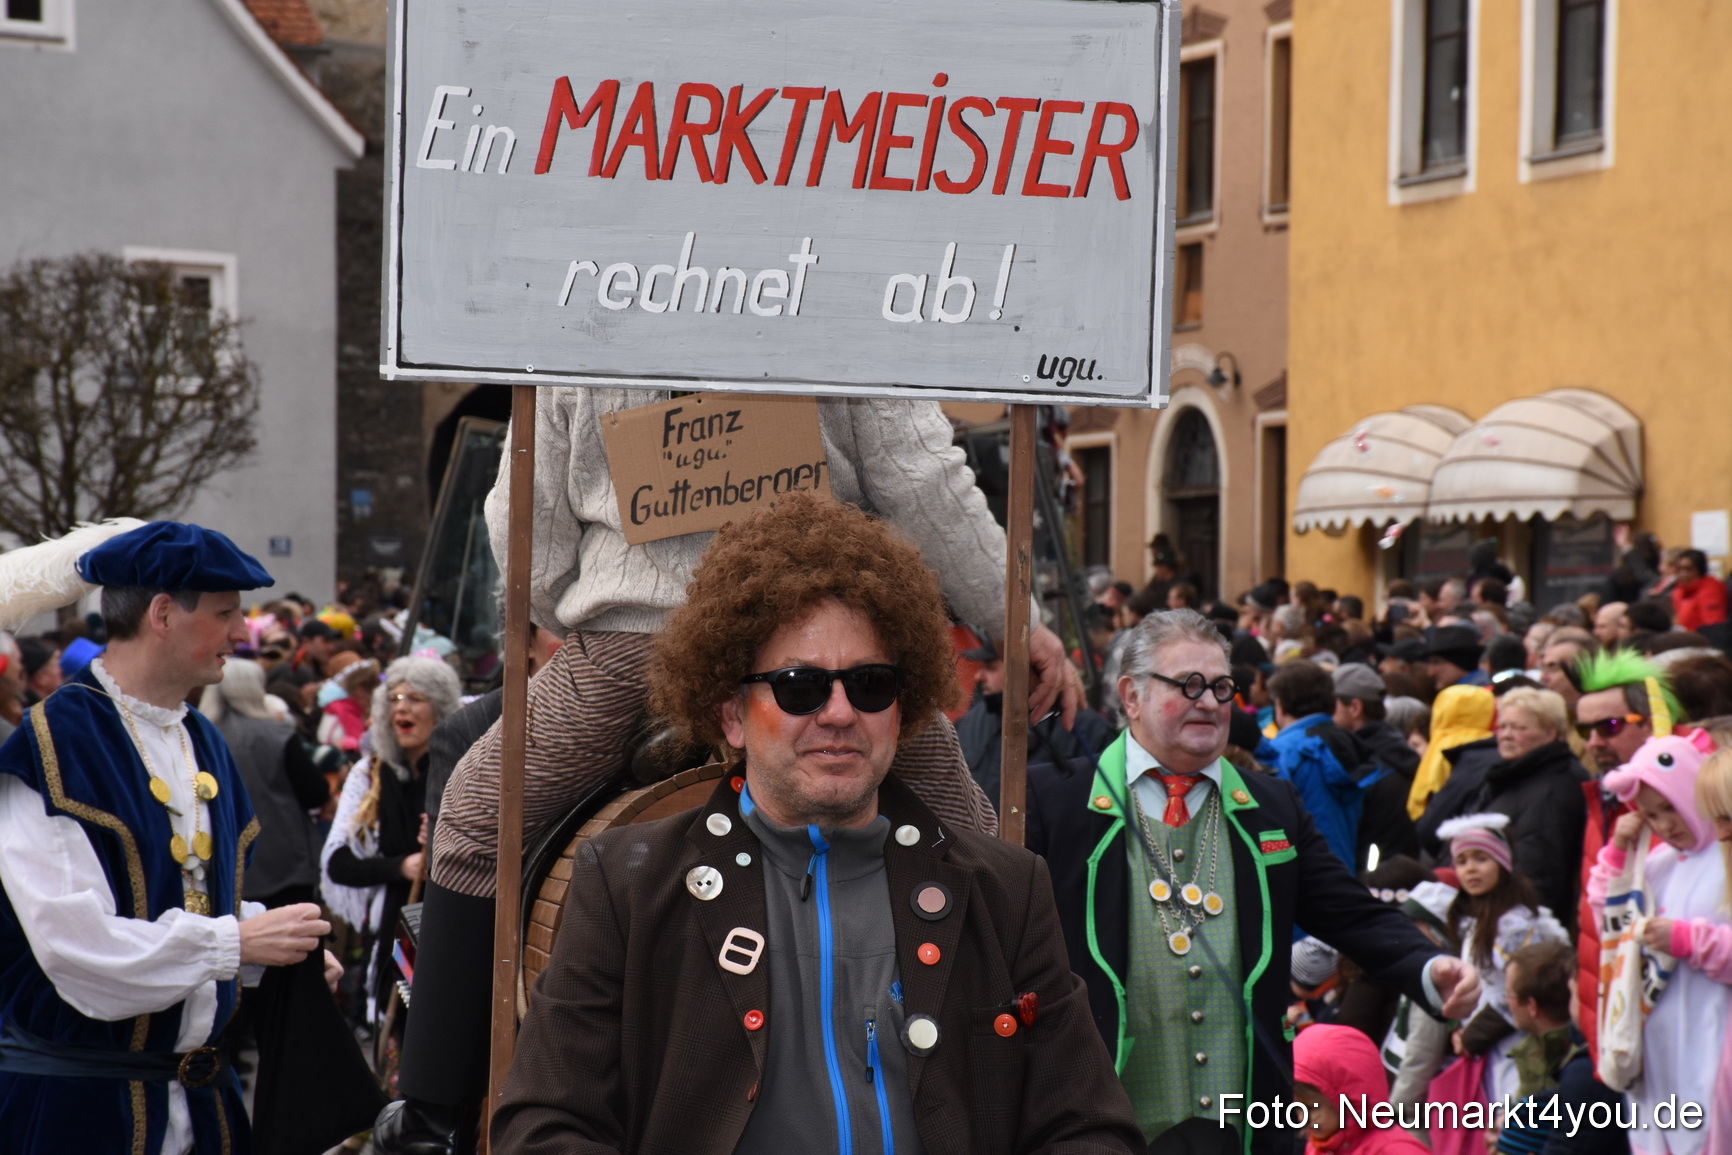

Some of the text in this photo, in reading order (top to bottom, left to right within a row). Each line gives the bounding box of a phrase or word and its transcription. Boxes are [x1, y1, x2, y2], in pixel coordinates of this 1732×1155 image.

[416, 84, 517, 174] Ein
[557, 231, 1017, 324] rechnet ab!
[1036, 353, 1104, 388] ugu.
[662, 406, 744, 449] Franz
